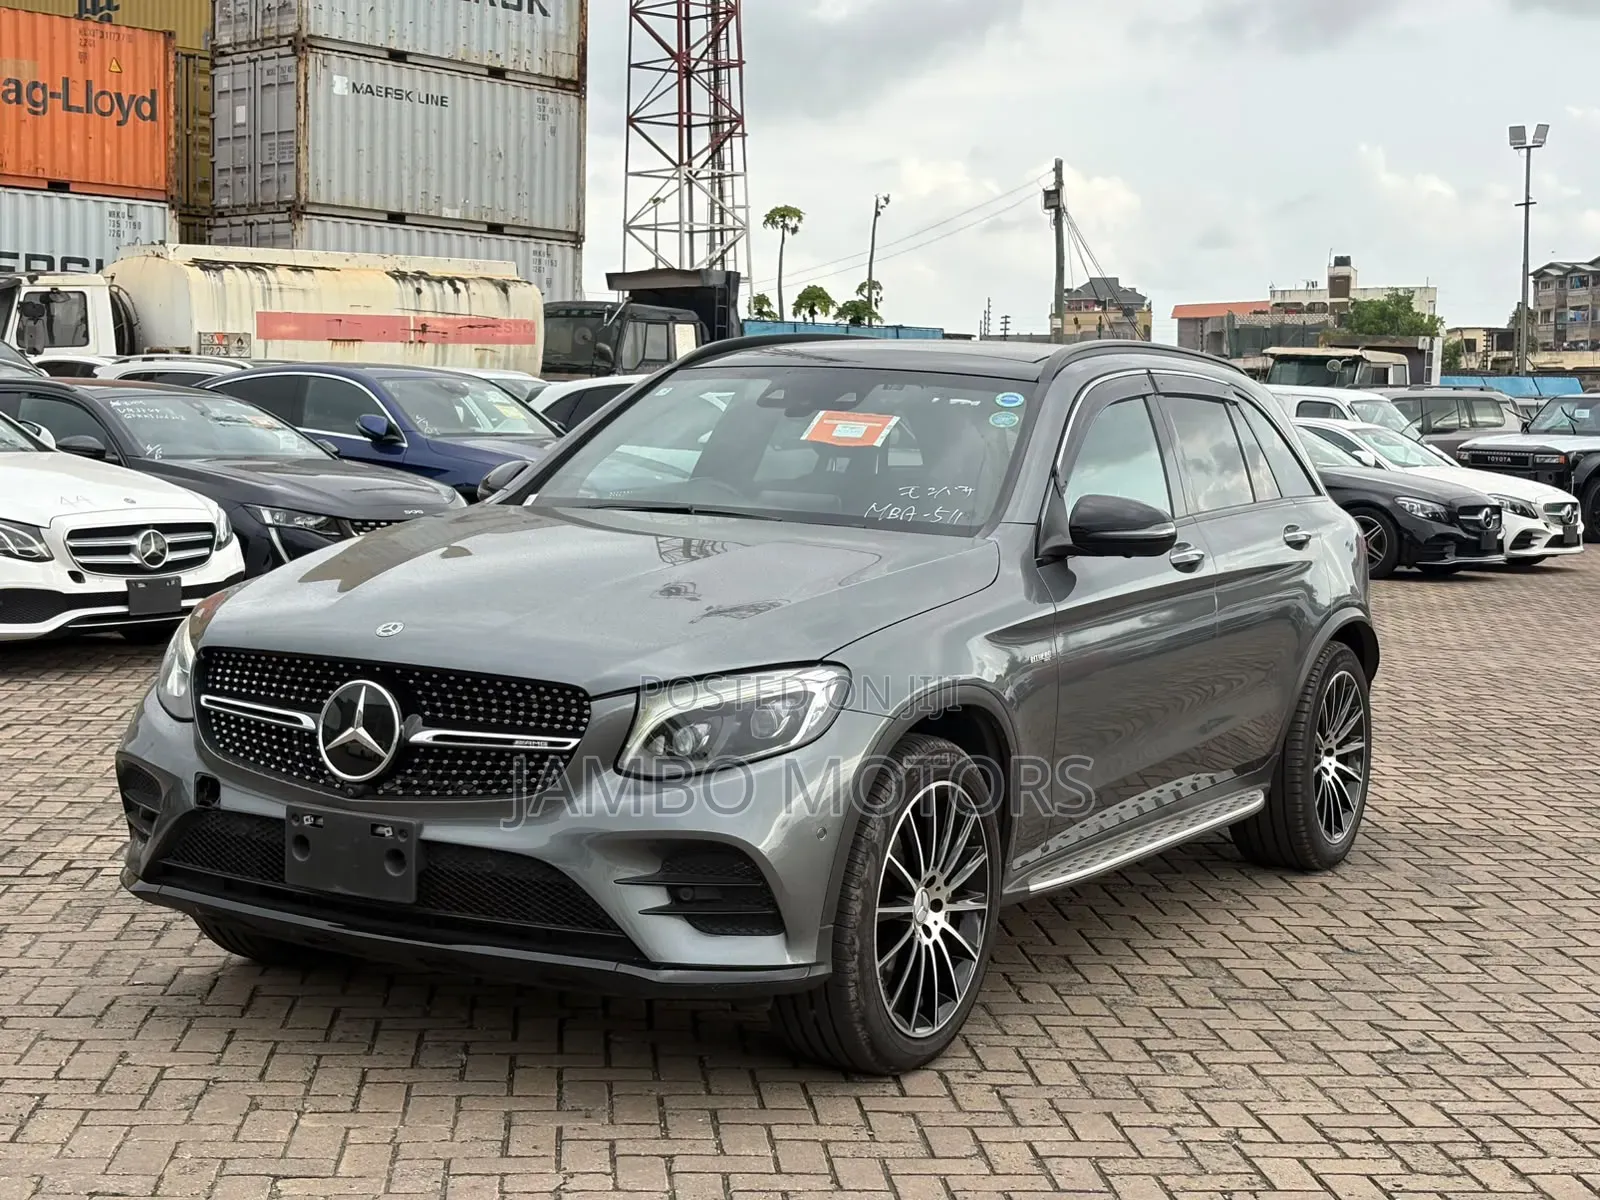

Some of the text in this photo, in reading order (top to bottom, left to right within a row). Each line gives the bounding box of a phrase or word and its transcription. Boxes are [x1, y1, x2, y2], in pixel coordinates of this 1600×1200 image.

[1, 77, 157, 126] ag-Lloyd
[352, 82, 449, 107] MAERSK LINE
[1487, 455, 1512, 464] TOYOTA
